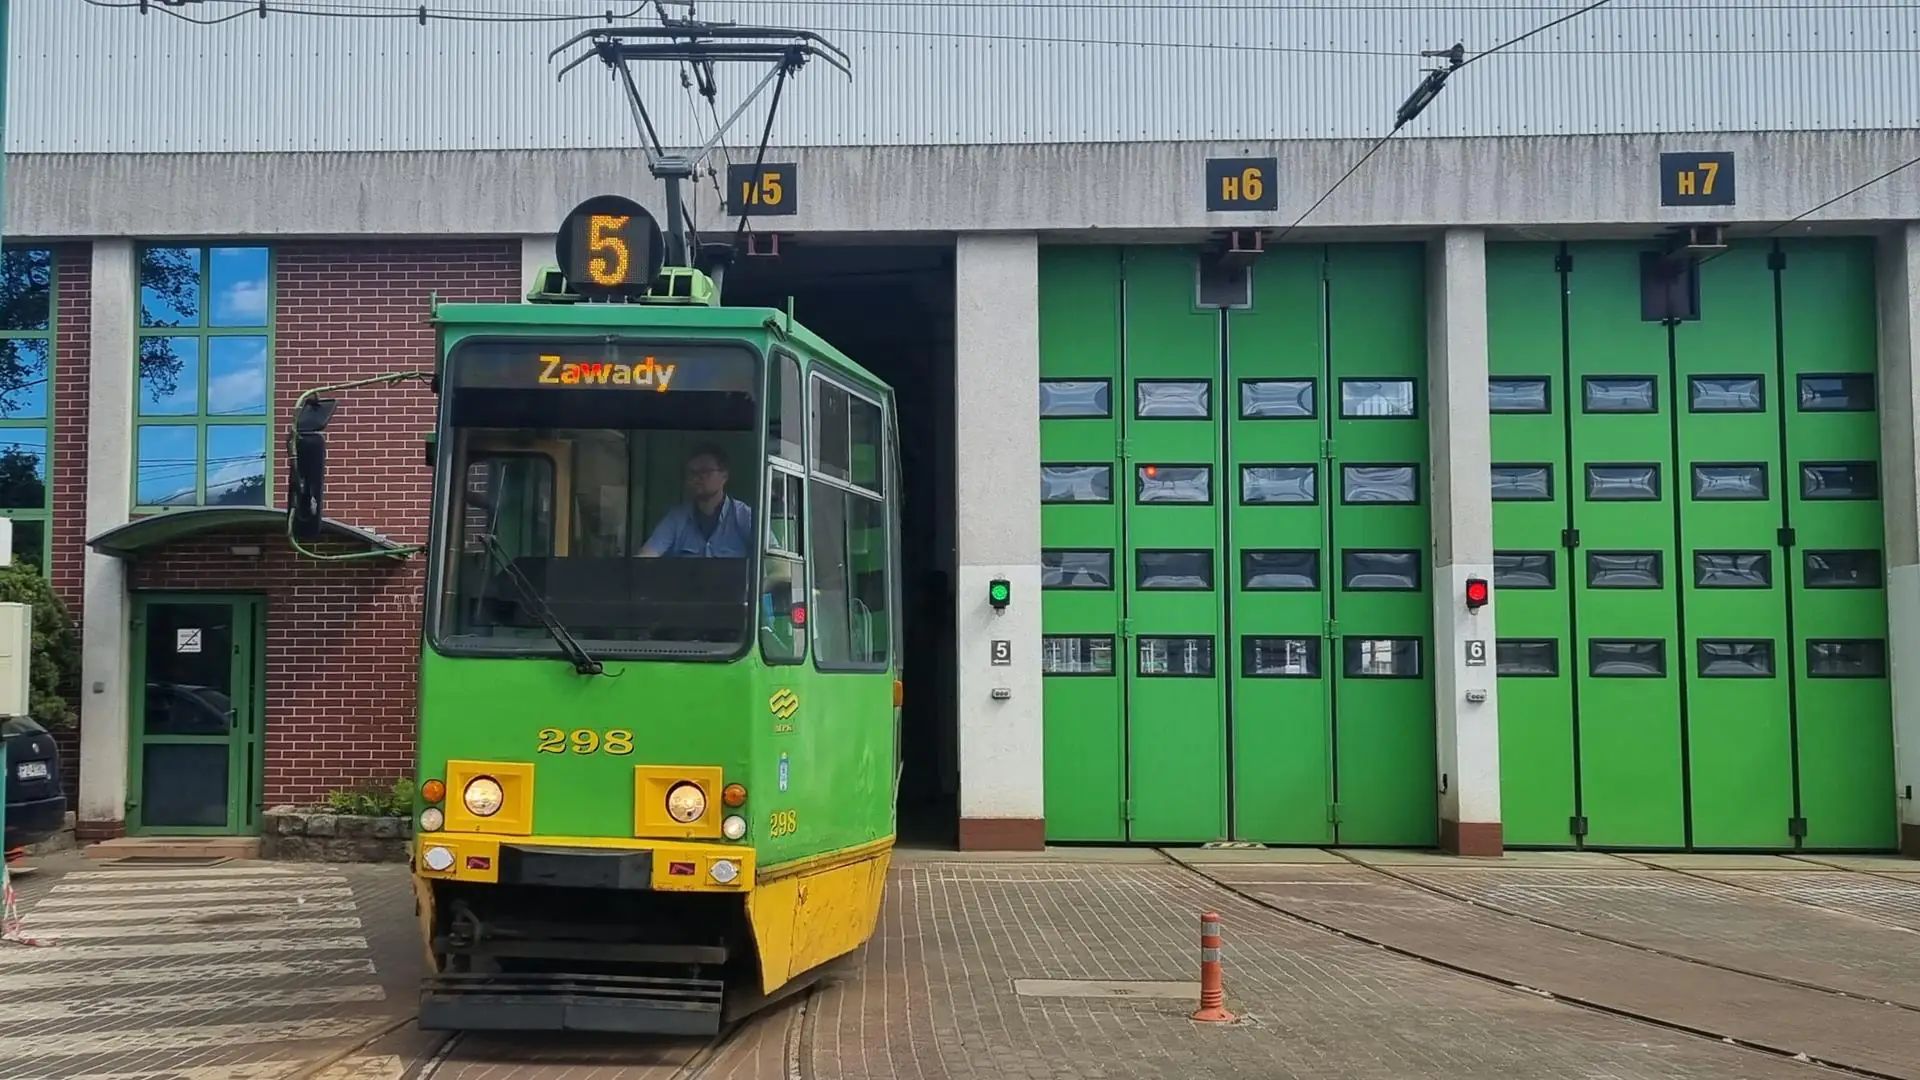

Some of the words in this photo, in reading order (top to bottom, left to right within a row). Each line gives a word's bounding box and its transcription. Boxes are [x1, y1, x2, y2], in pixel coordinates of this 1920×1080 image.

[1222, 167, 1262, 200] H6
[1678, 162, 1719, 195] H7
[589, 213, 630, 285] 5
[538, 354, 675, 392] Zawady
[996, 642, 1008, 658] 5
[1471, 642, 1483, 658] 6
[537, 728, 634, 755] 298
[770, 810, 797, 839] 298
